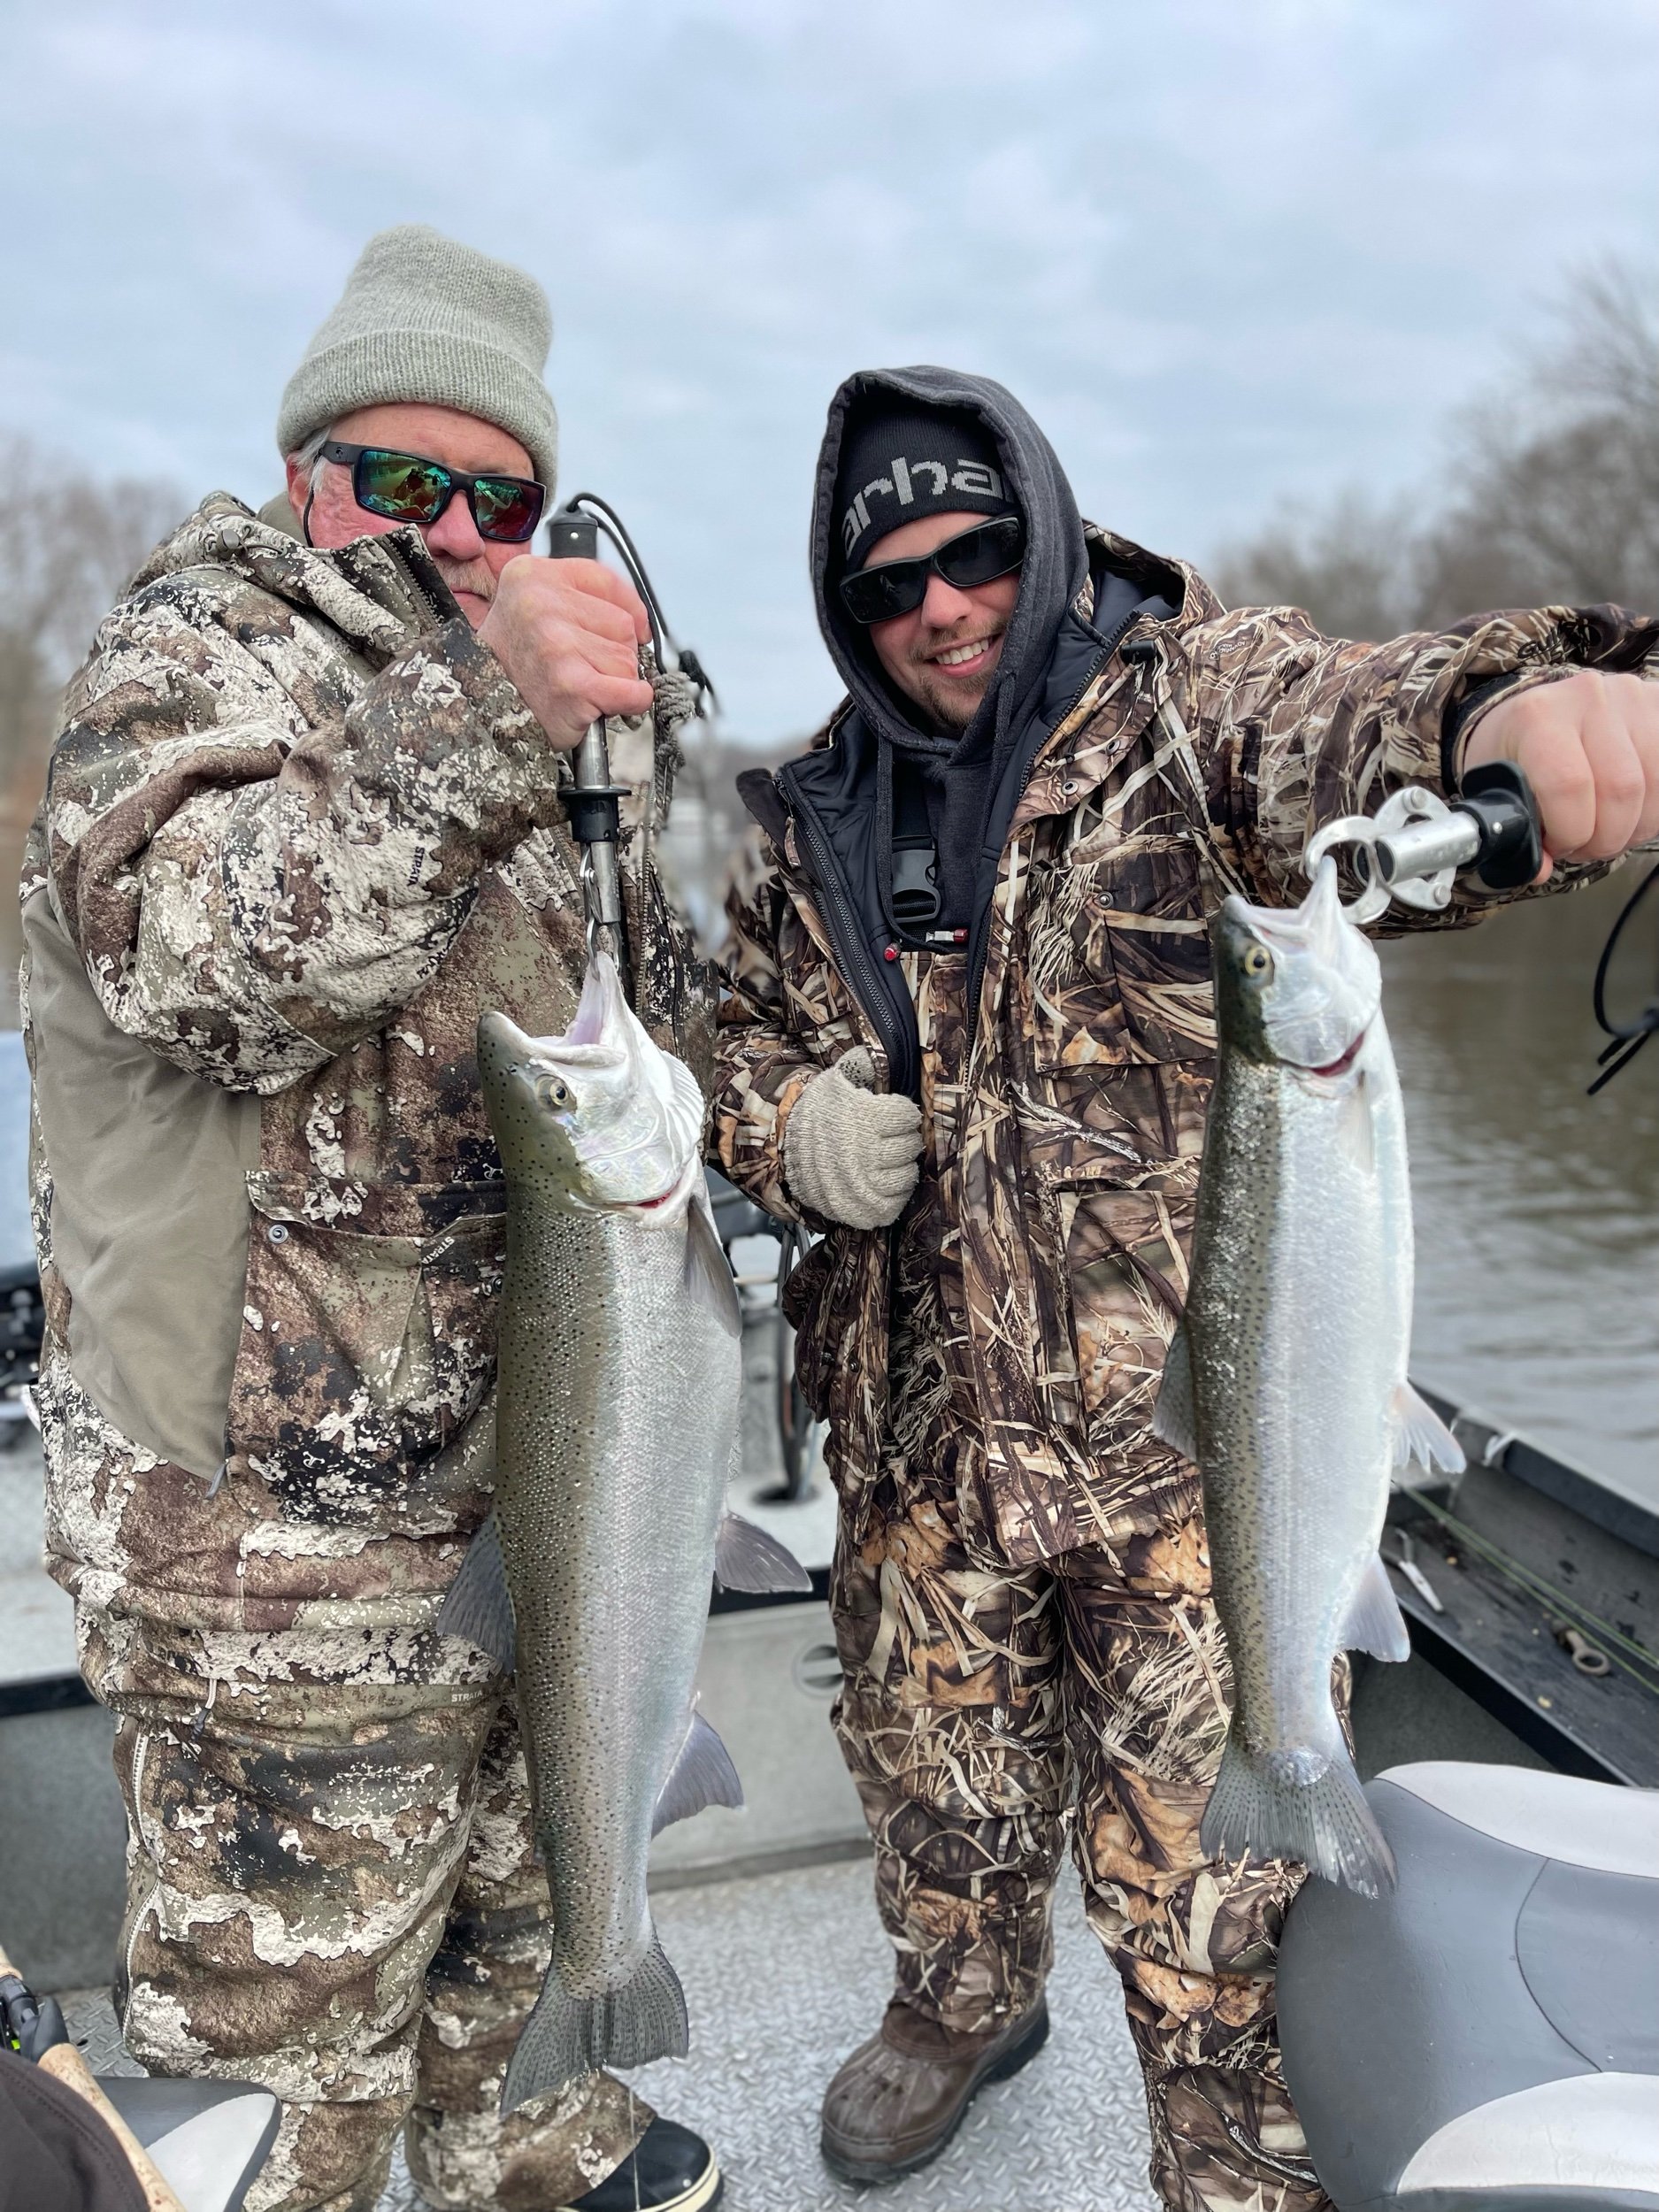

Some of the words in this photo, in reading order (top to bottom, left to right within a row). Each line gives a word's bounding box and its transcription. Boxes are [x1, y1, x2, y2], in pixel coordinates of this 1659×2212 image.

[841, 457, 1003, 560] arha
[407, 846, 425, 887] STRATA
[421, 1236, 455, 1264] STRATA
[451, 1690, 483, 1702] STRATA
